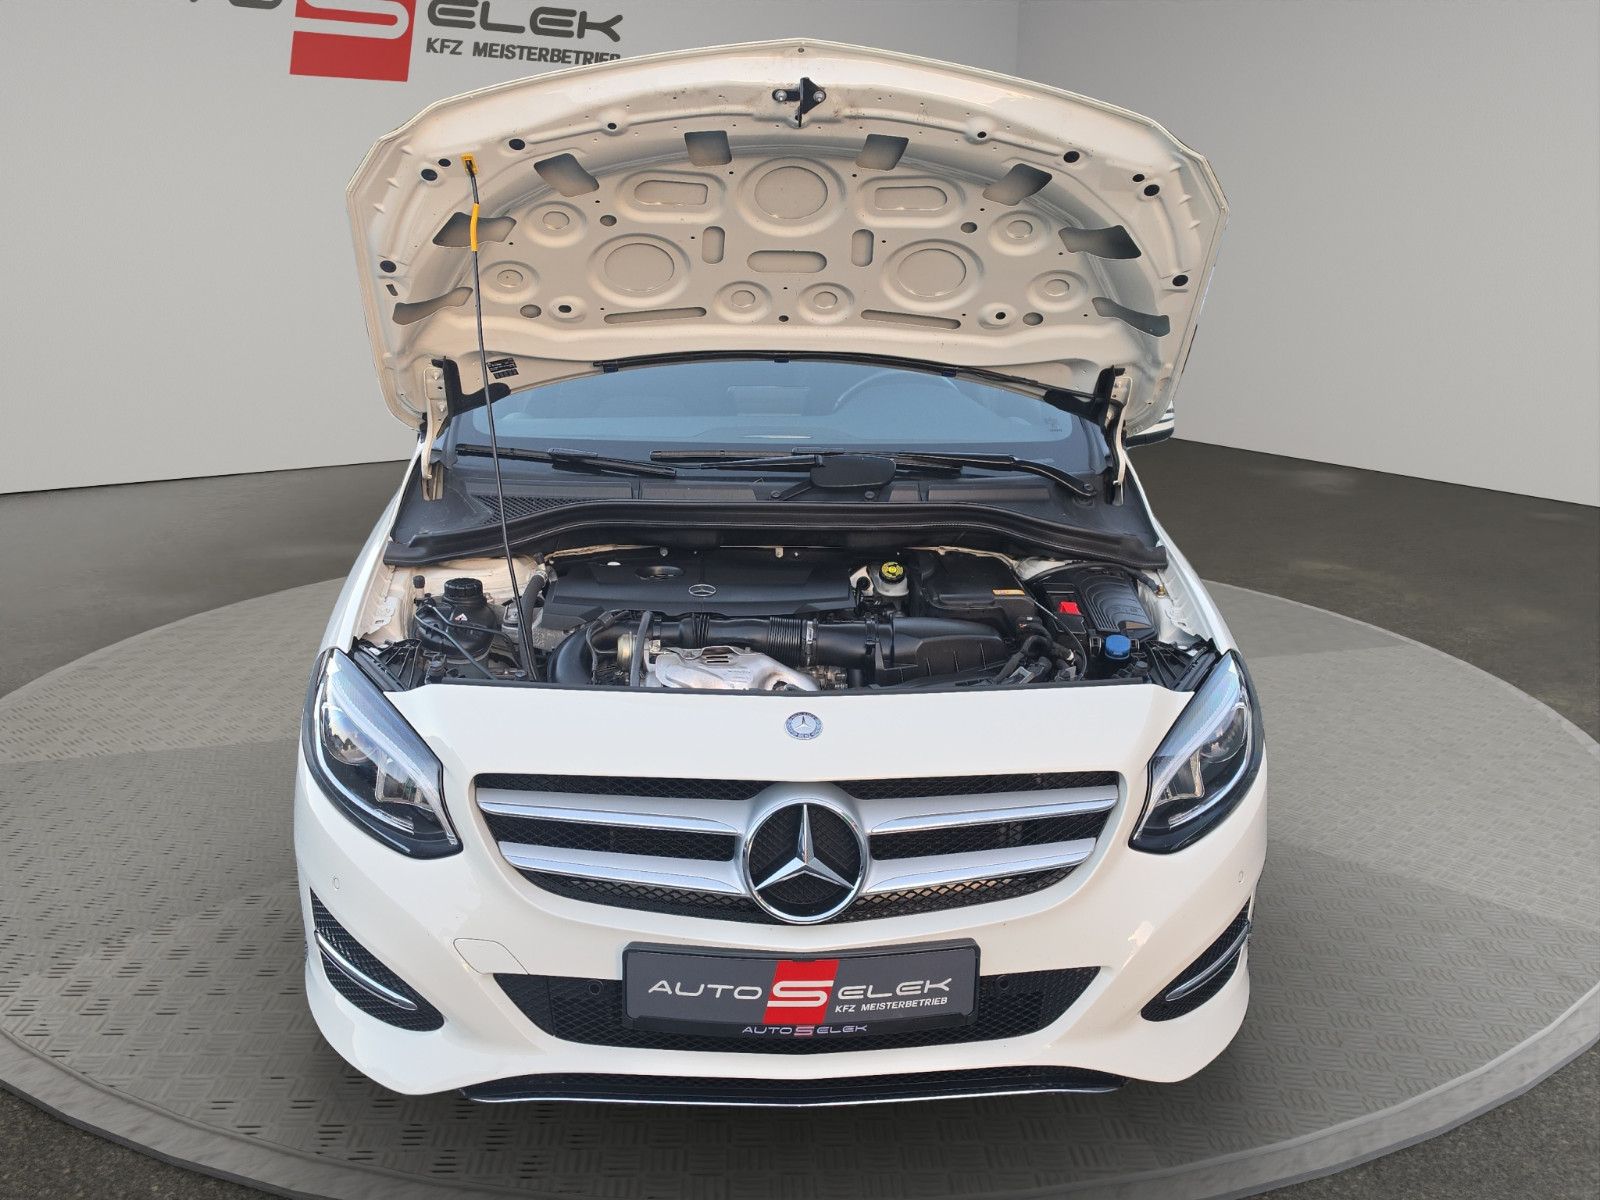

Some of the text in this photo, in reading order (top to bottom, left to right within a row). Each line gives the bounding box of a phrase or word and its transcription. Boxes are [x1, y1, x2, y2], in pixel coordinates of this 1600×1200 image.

[425, 37, 464, 55] KFZ
[834, 997, 948, 1013] KFZ MEISTERBETRIEB
